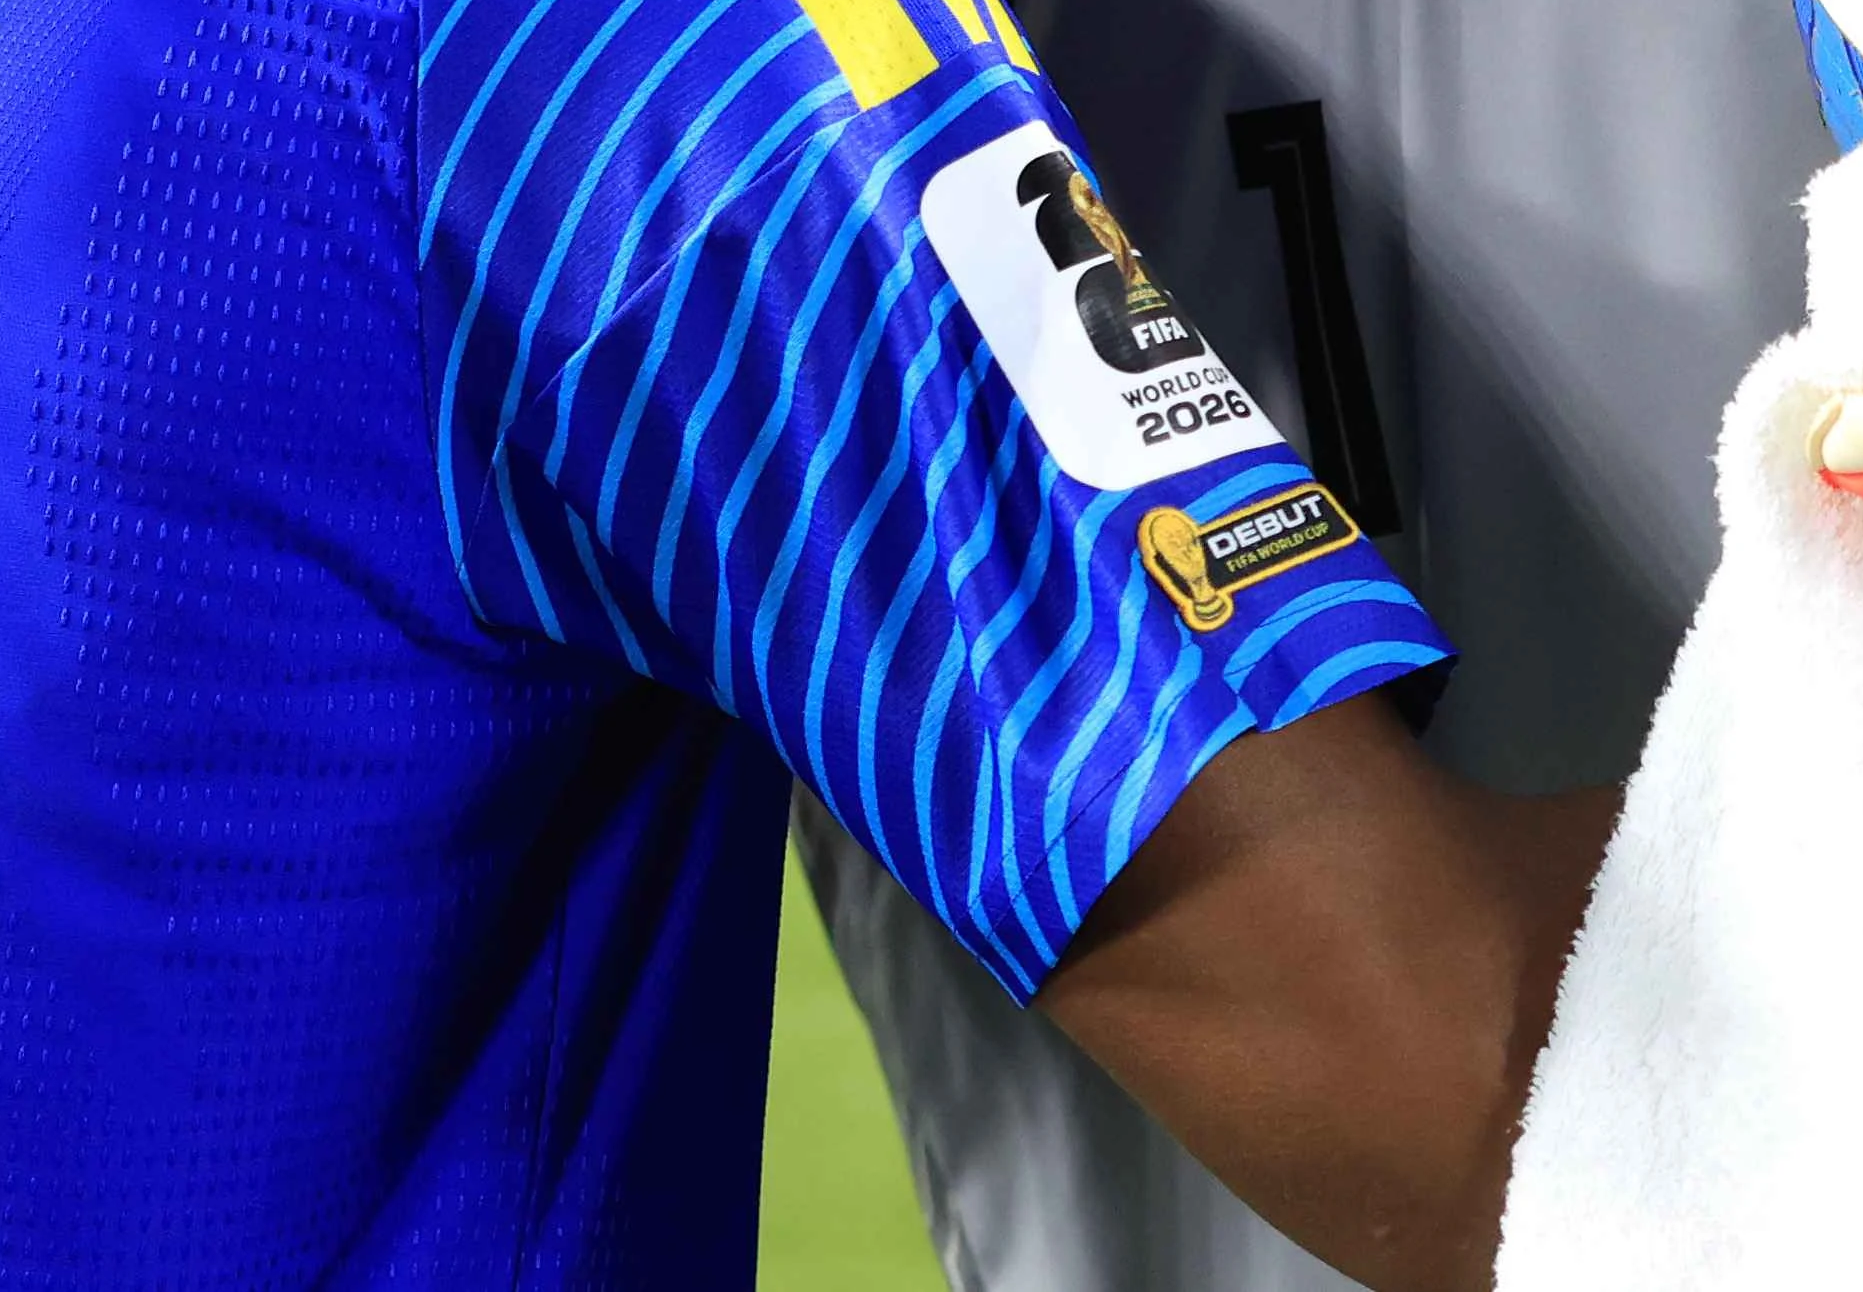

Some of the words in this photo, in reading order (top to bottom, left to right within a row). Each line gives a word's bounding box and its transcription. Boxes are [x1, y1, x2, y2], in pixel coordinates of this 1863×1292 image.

[1131, 316, 1189, 350] FIFA
[1121, 371, 1202, 408] WORLD
[1136, 389, 1252, 446] 2026
[1207, 494, 1323, 559] DEBUT
[1226, 551, 1259, 573] FIFA
[1256, 532, 1305, 559] WORLD
[1304, 521, 1330, 541] CUP
